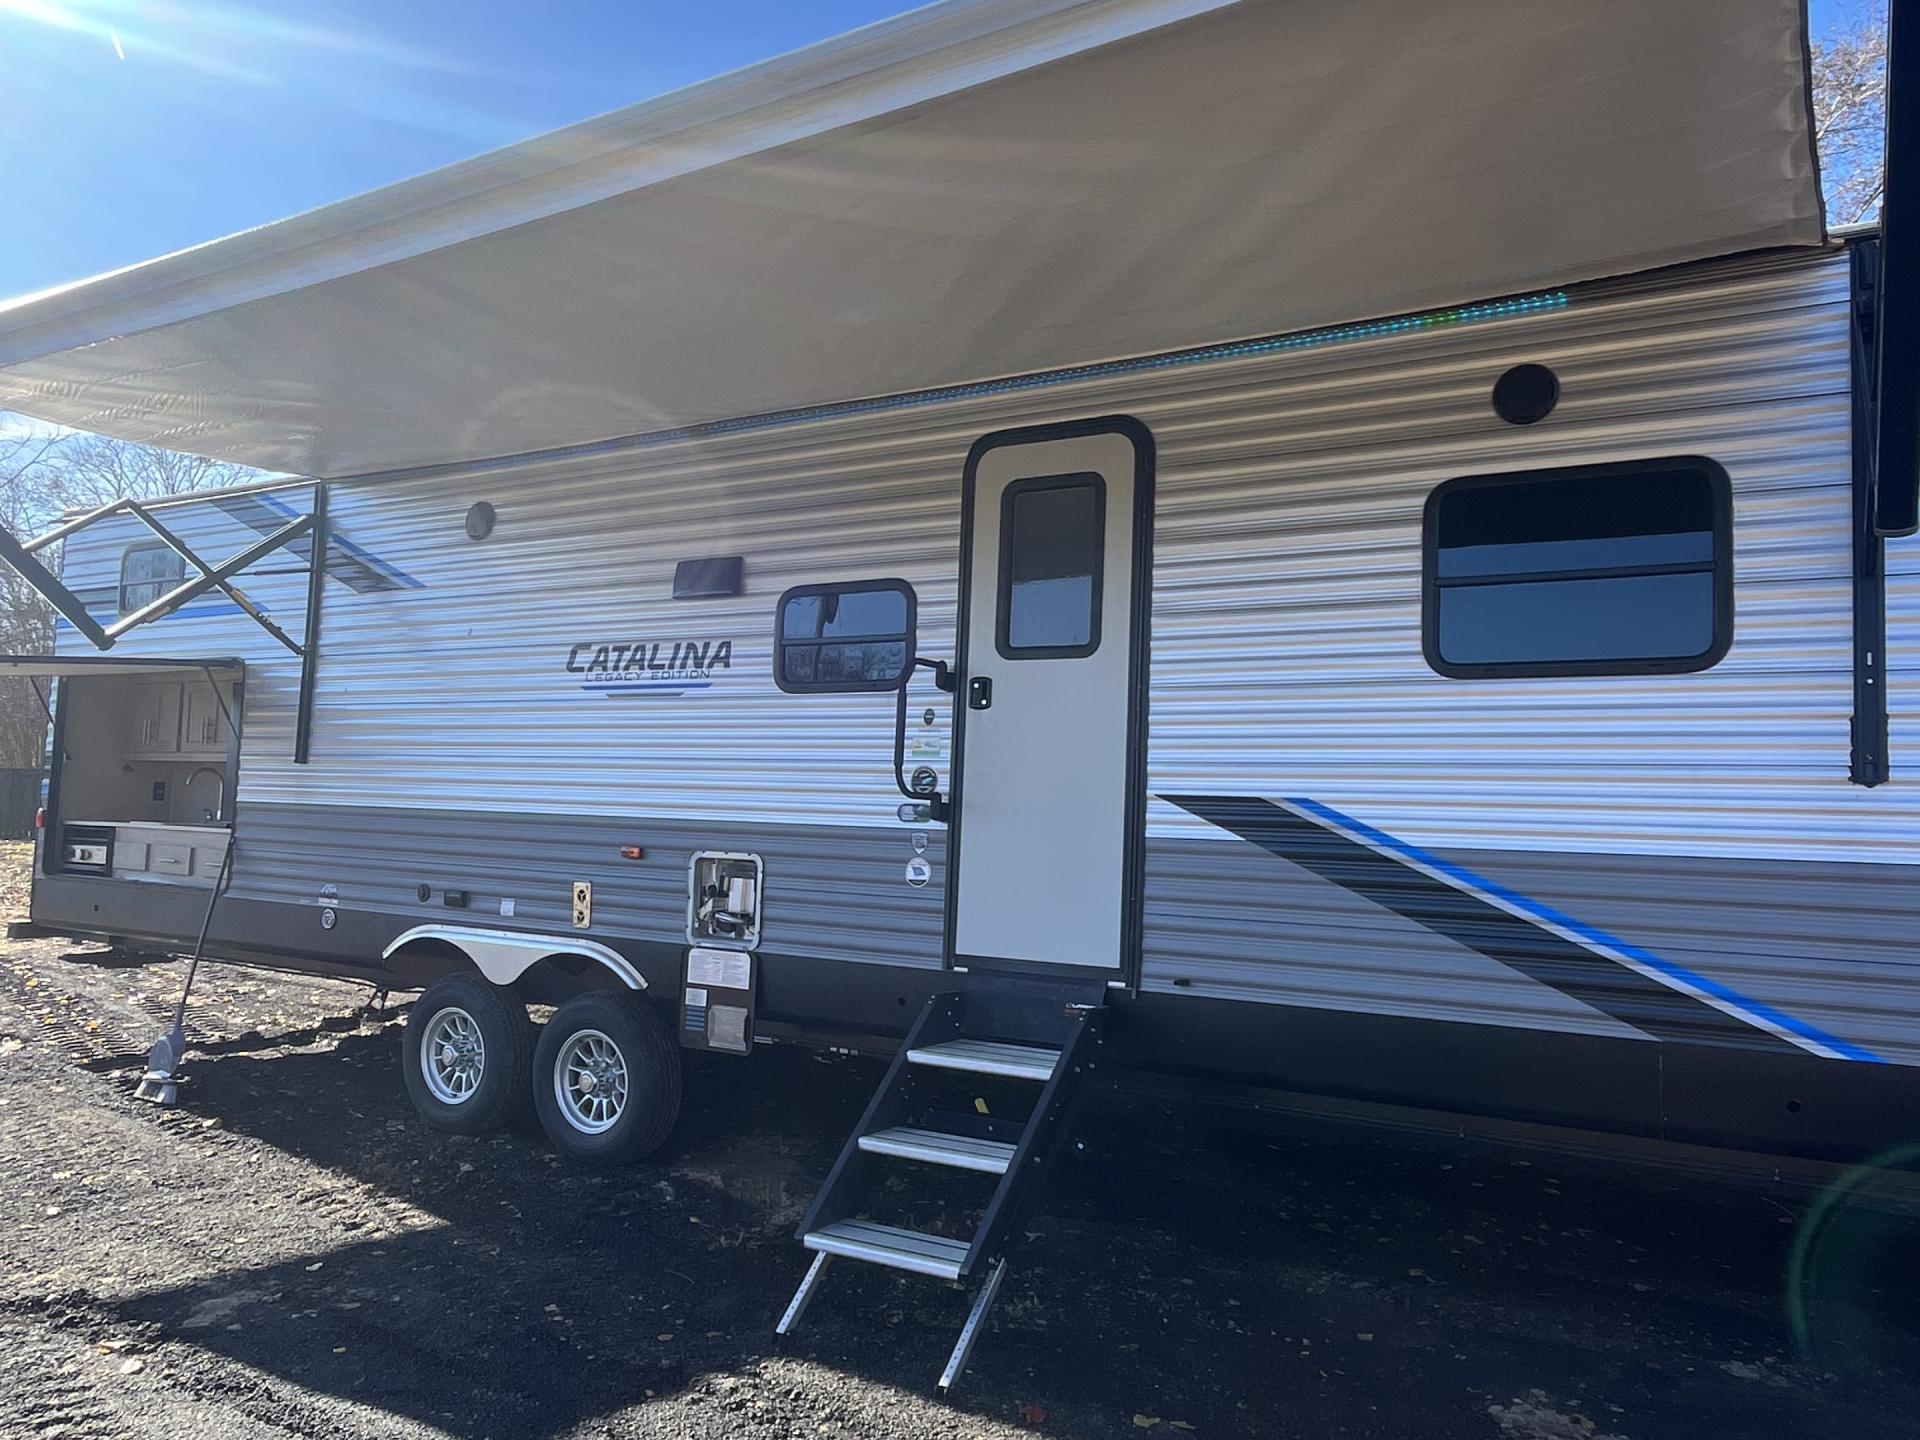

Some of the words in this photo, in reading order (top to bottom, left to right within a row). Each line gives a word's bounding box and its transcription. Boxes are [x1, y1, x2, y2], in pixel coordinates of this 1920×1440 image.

[566, 640, 732, 673] CATALINA
[585, 671, 643, 682] LEGACY
[650, 669, 711, 680] EDITION
